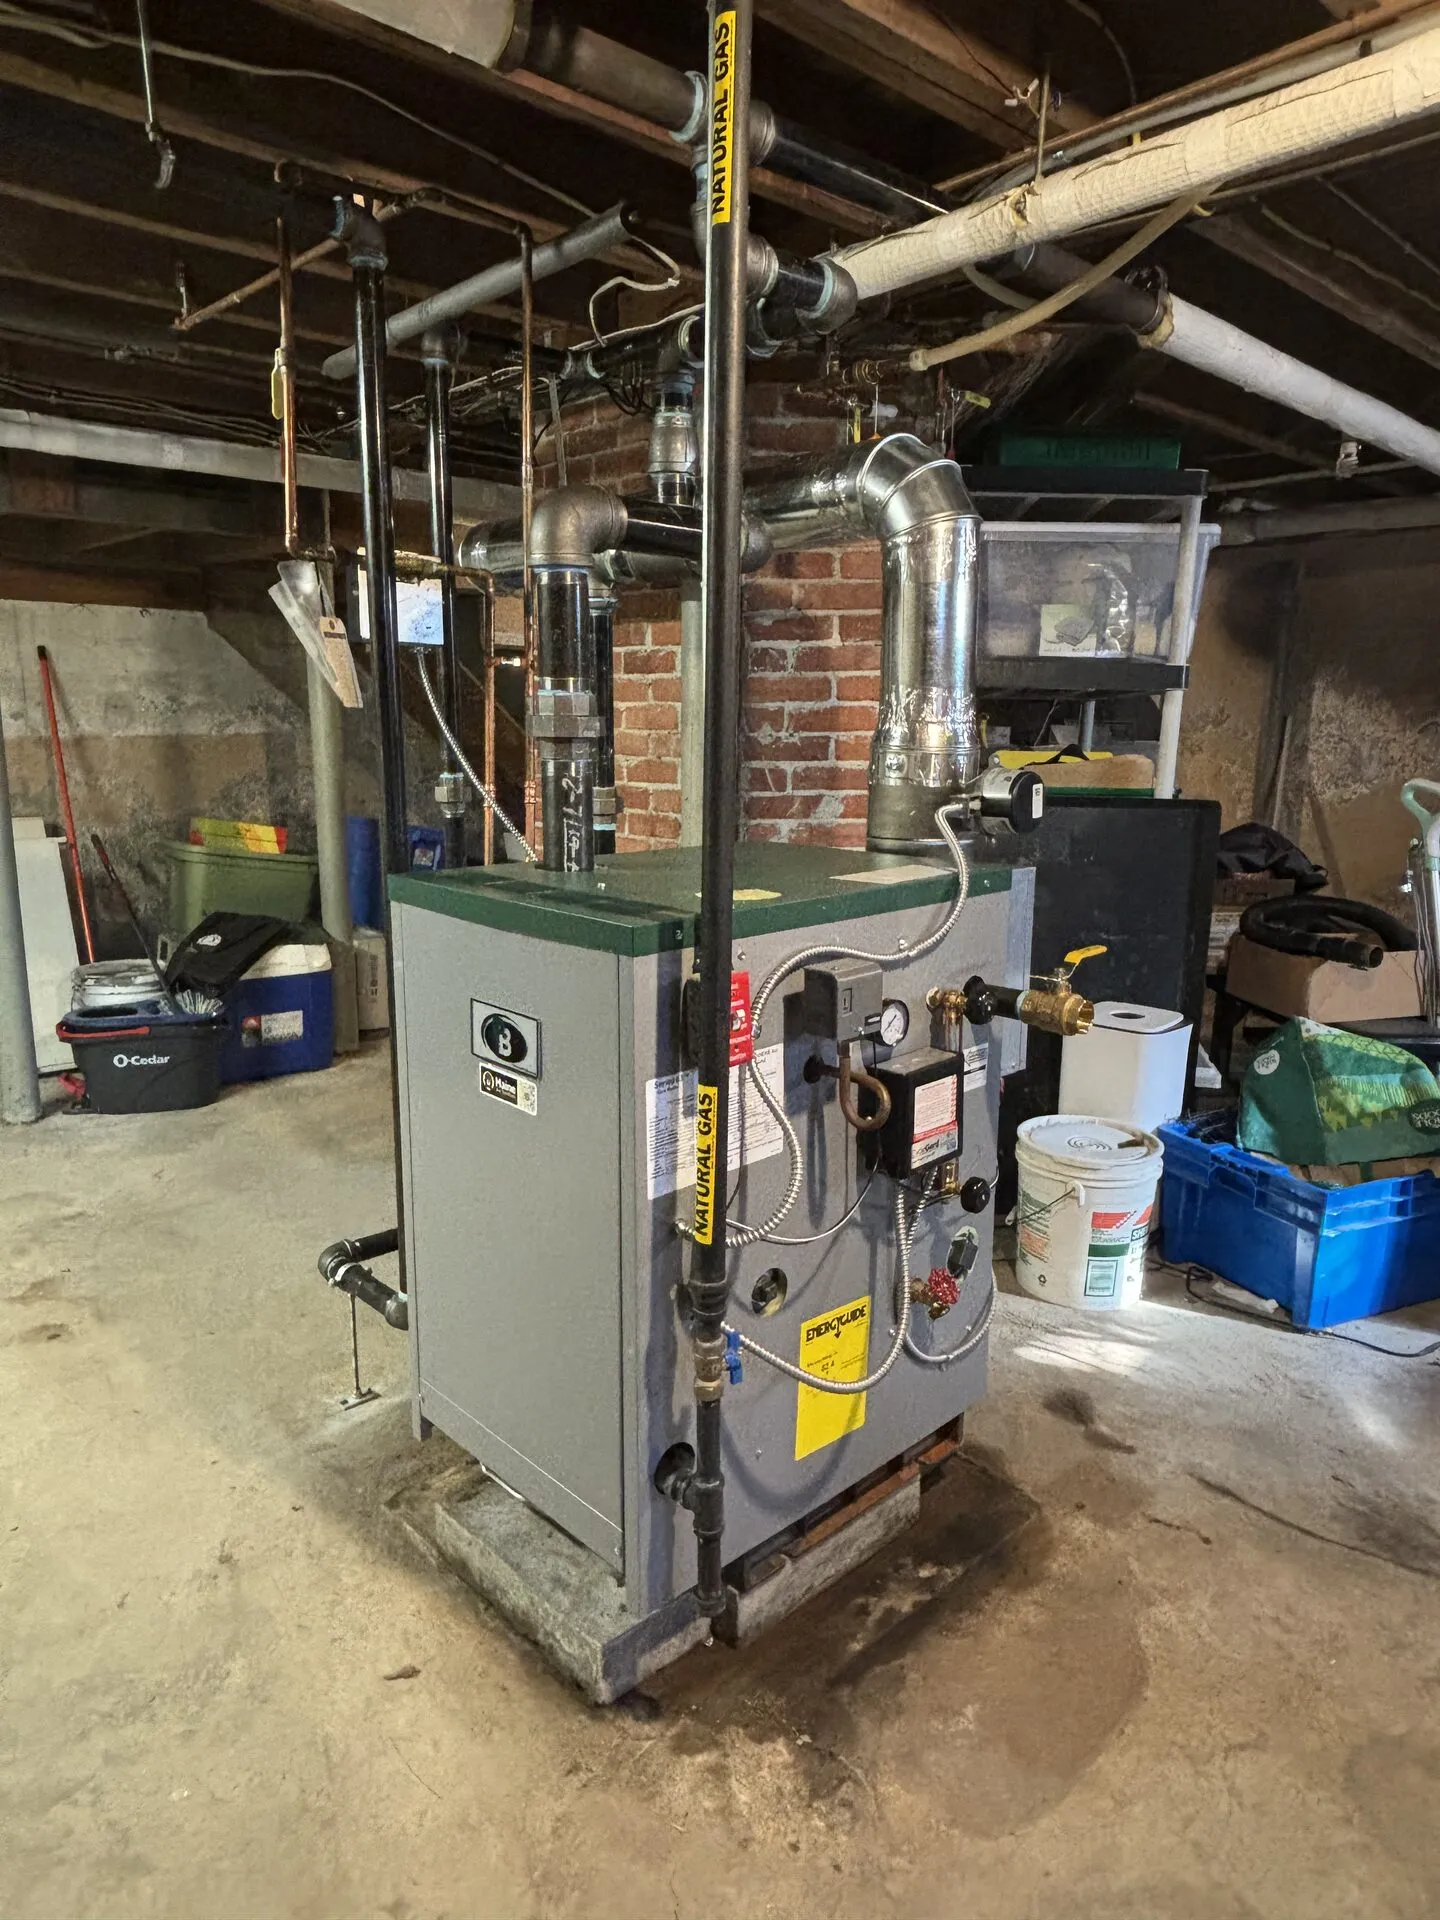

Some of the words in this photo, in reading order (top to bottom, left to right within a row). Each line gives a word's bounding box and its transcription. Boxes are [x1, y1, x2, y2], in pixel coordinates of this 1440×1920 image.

[714, 22, 730, 83] GAS
[712, 89, 728, 214] NATURAL
[113, 1053, 171, 1068] O-Cedar
[698, 1093, 713, 1136] GAS
[695, 1143, 711, 1236] NATURAL
[805, 1304, 867, 1342] ENERGYGUIDE
